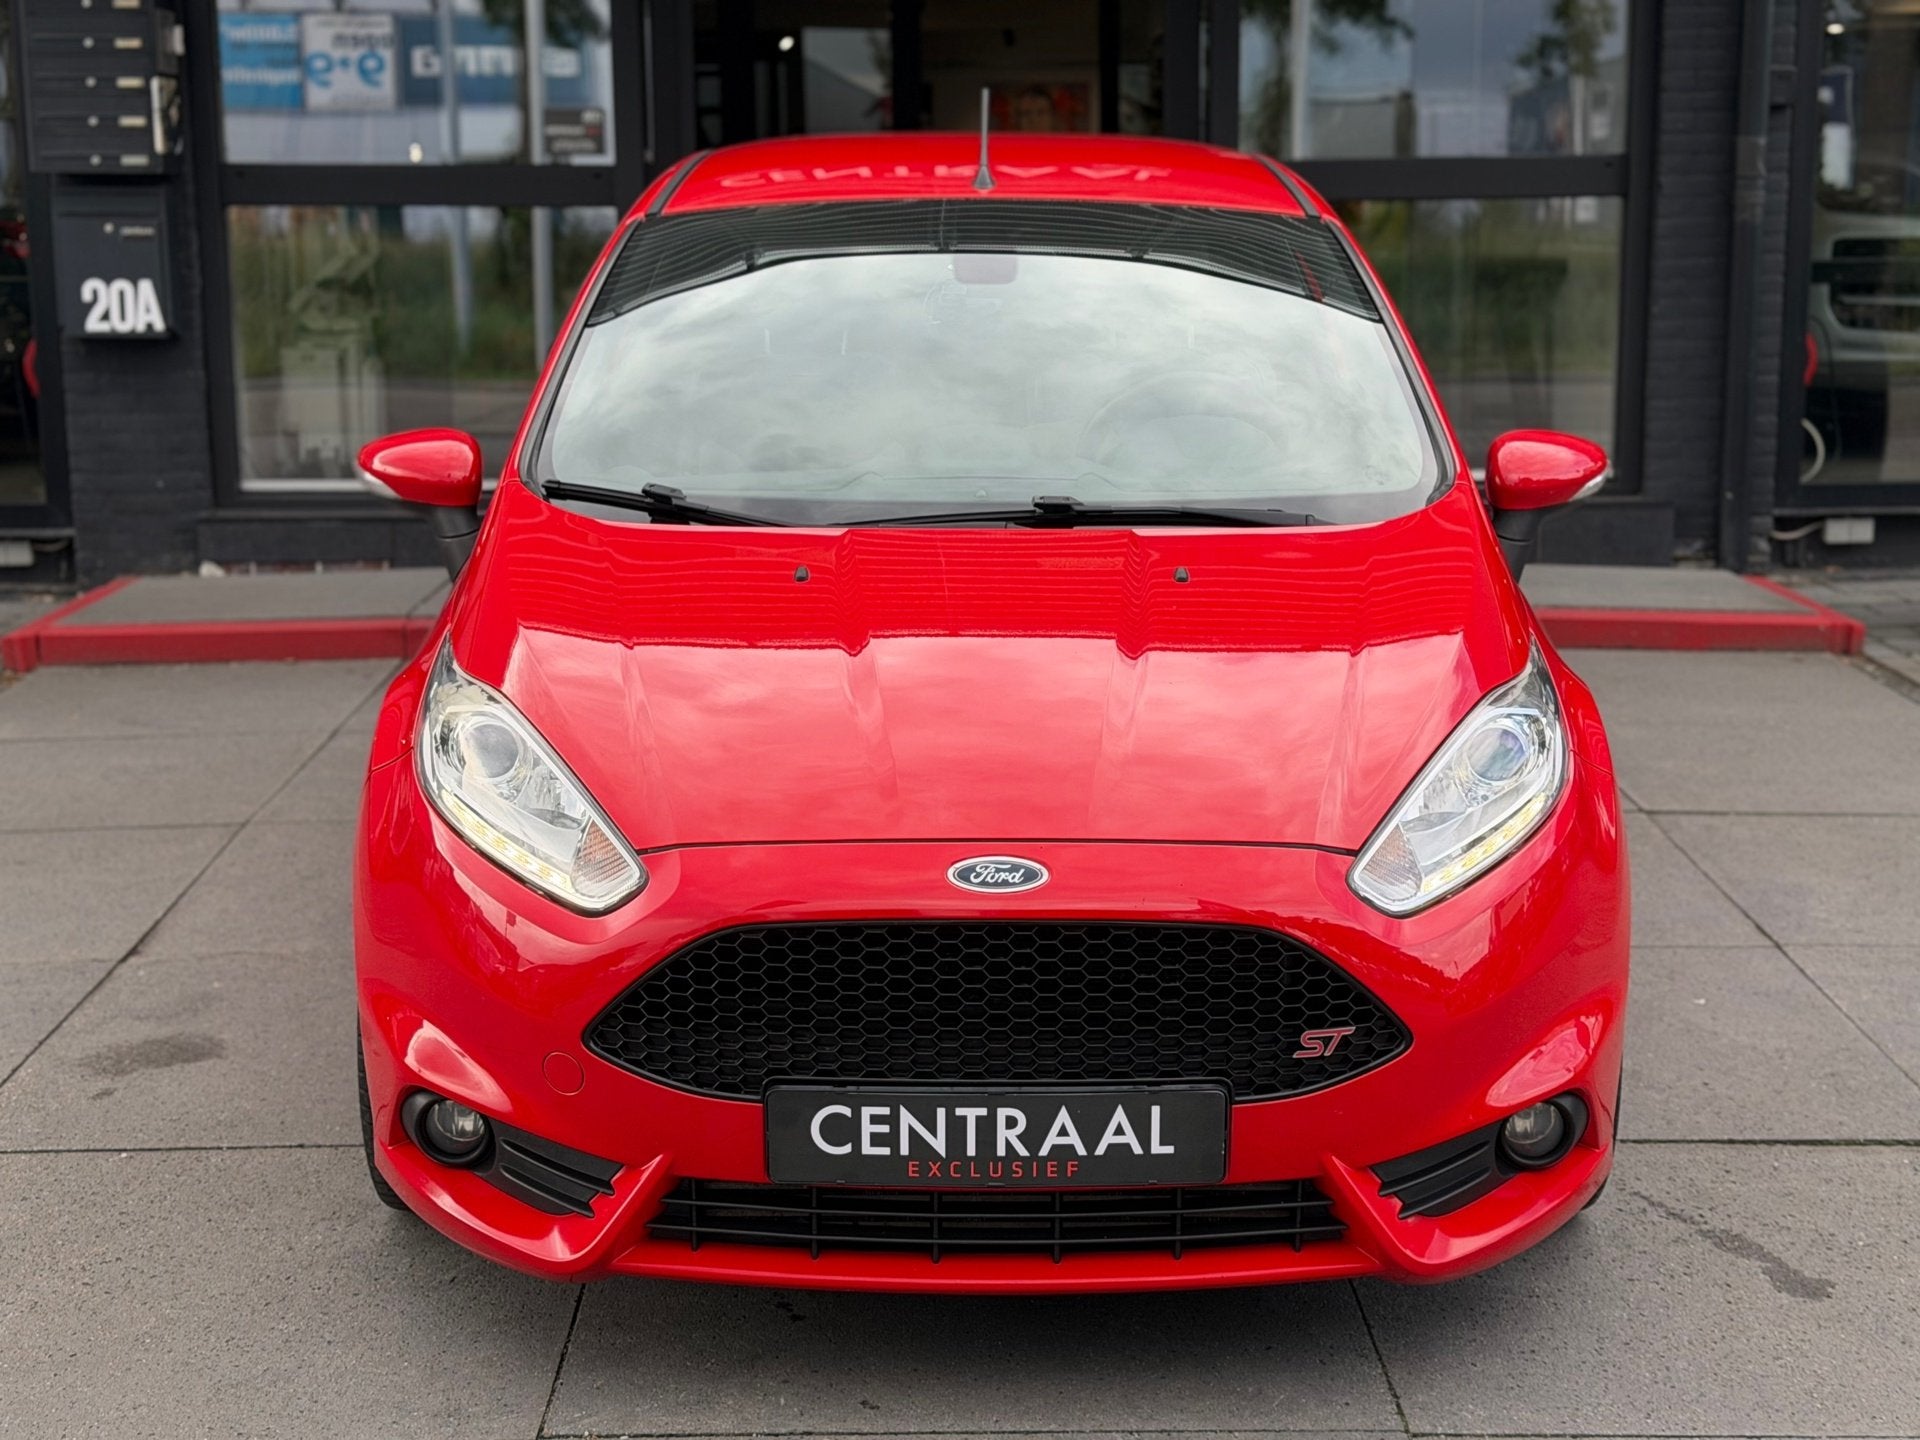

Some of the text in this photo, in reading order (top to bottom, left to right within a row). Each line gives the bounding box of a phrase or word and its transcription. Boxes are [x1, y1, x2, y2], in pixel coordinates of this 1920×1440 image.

[81, 277, 166, 333] 20A
[970, 863, 1025, 884] Ford
[1292, 1026, 1356, 1058] ST
[810, 1104, 1175, 1157] CENTRAAL
[907, 1160, 1080, 1178] EXCLUSIEF
